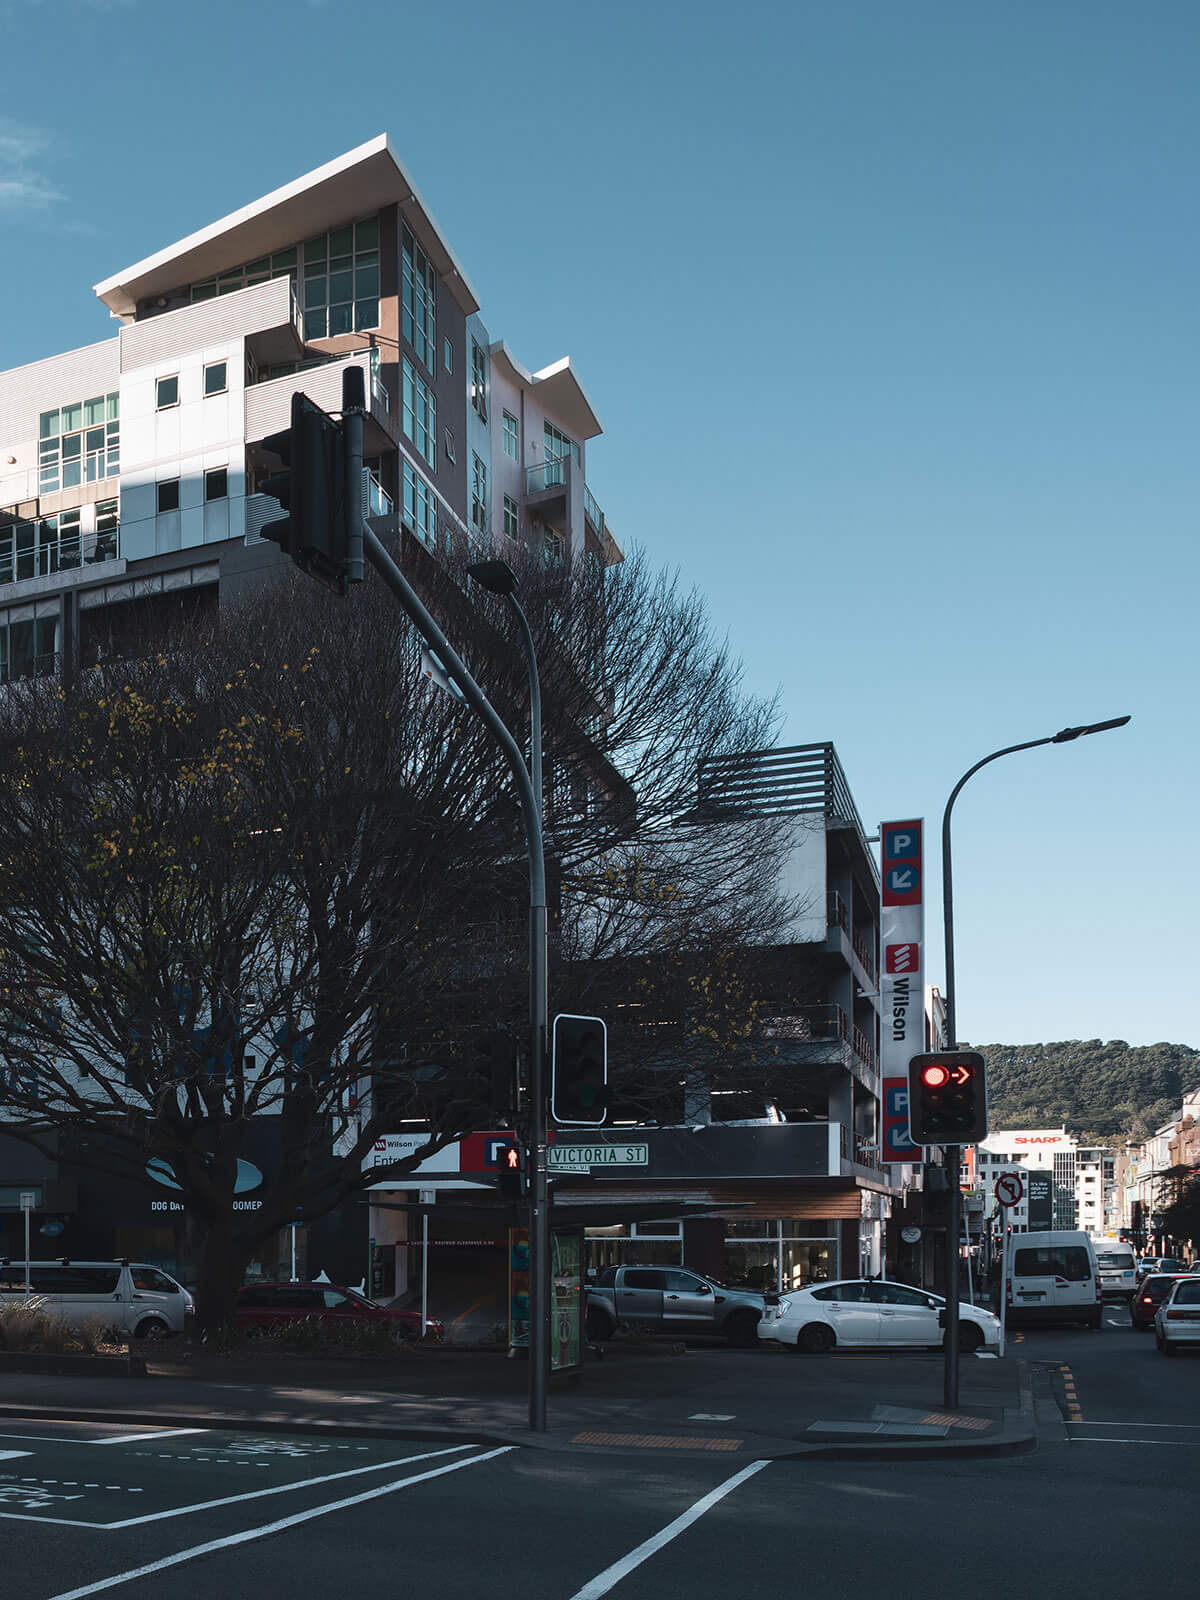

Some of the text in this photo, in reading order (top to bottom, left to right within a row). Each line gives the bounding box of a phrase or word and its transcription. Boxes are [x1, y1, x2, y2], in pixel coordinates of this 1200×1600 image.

[894, 834, 911, 854] P
[893, 977, 909, 1041] Wilson
[1015, 1136, 1062, 1144] SHARP
[554, 1148, 642, 1162] VICTORIA ST
[152, 1201, 167, 1211] DOG
